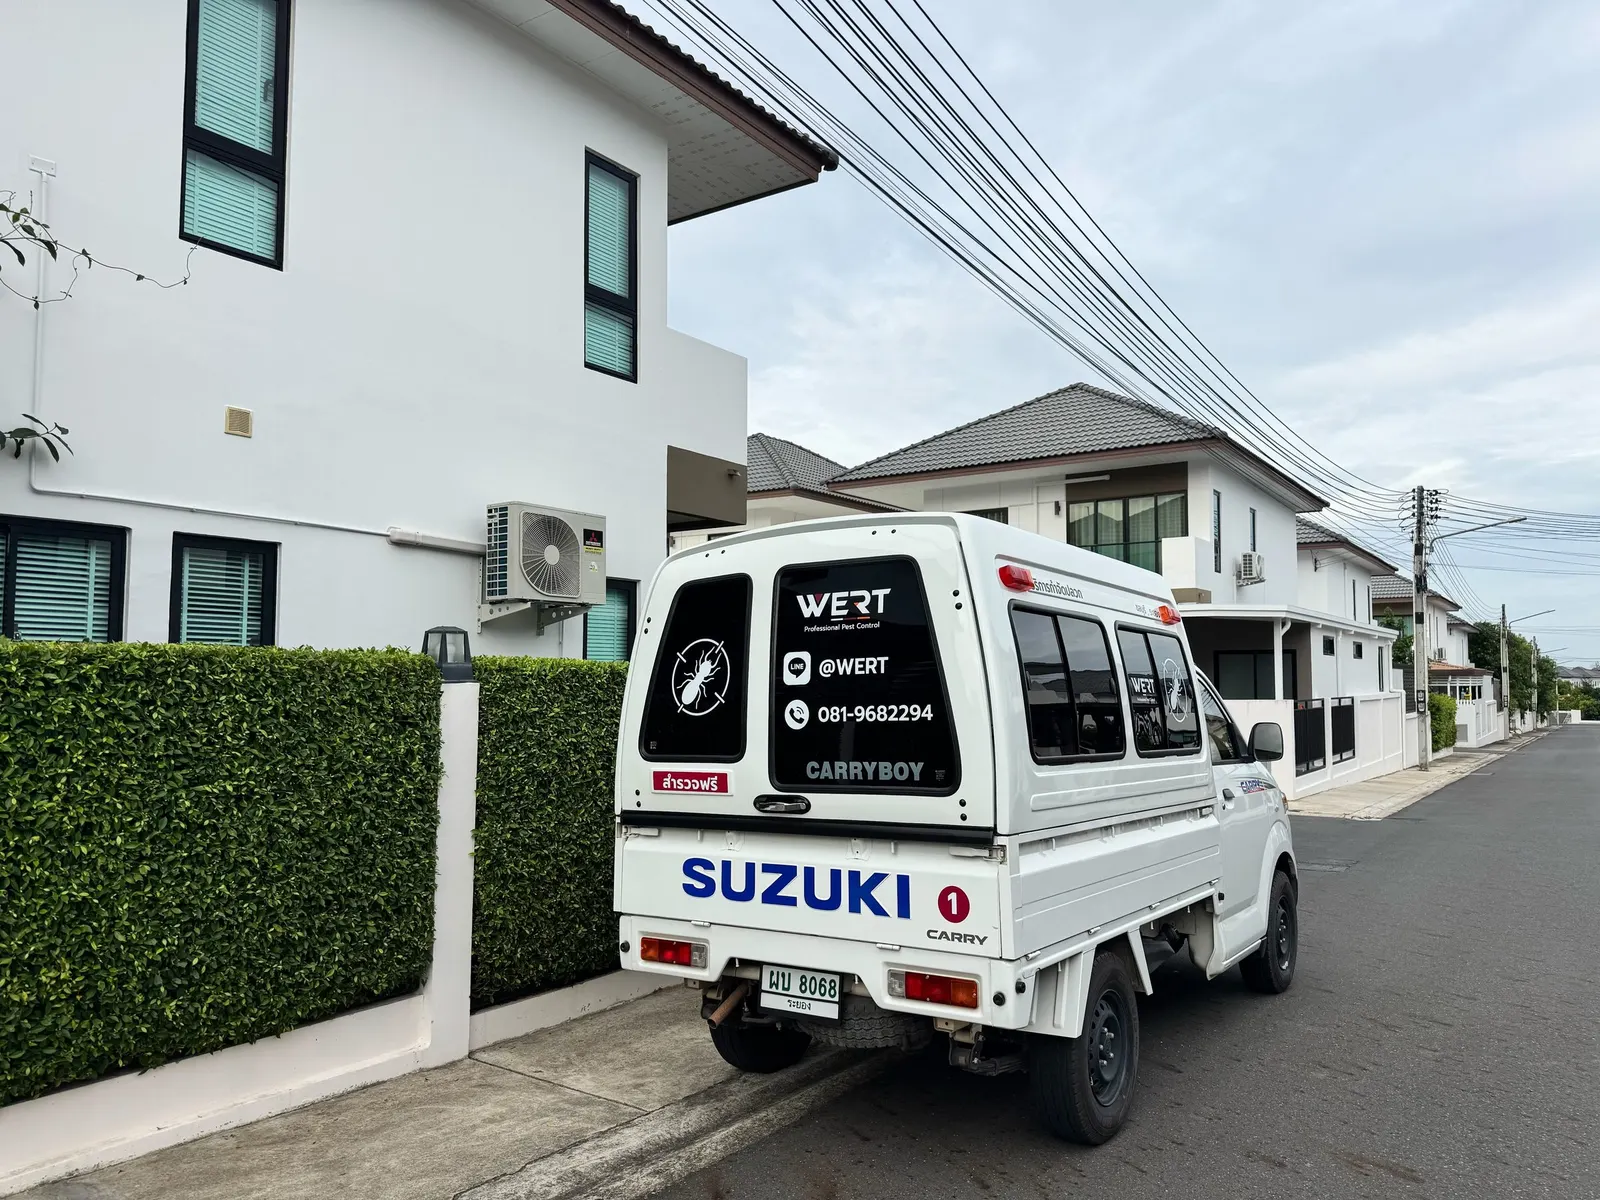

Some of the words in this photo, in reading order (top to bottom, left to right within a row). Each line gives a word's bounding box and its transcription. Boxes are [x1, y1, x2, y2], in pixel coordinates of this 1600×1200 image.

[1033, 578, 1083, 599] ริการกำจัดปลวก
[796, 588, 891, 618] WERT
[804, 623, 840, 632] Professional
[841, 623, 855, 631] Pest
[856, 621, 880, 630] Control
[790, 662, 804, 670] LINE
[819, 656, 889, 677] @WERT
[1130, 677, 1155, 693] WERT
[818, 704, 933, 722] 081-9682294
[806, 761, 924, 781] CARRYBOY
[663, 773, 718, 791] สำรวจฟรี
[682, 857, 911, 919] SUZUKI
[947, 892, 957, 915] 1
[926, 929, 988, 945] CARRY
[799, 974, 837, 998] 8068
[787, 999, 811, 1011] ระยอง
